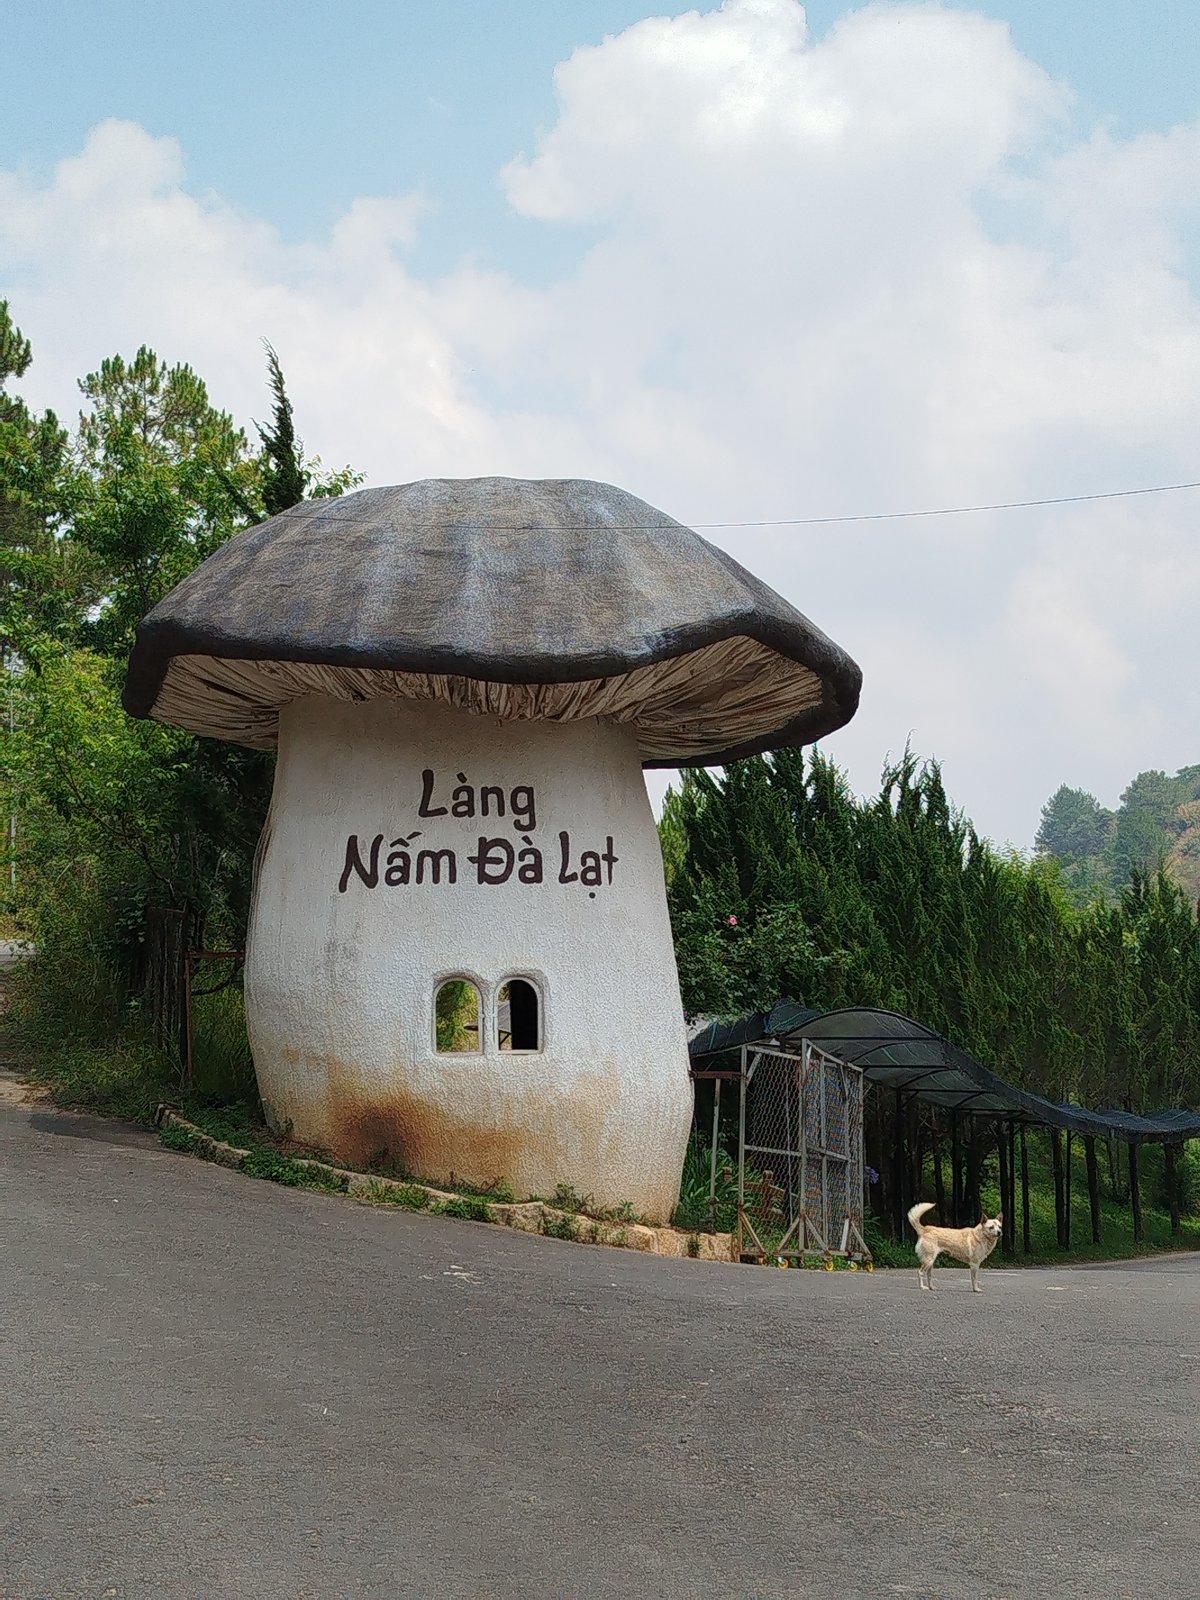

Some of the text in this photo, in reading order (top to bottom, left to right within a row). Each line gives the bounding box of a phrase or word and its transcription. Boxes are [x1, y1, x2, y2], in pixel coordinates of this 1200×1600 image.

[418, 769, 537, 832] Làng
[338, 831, 619, 899] Nấm Đà Lạt
